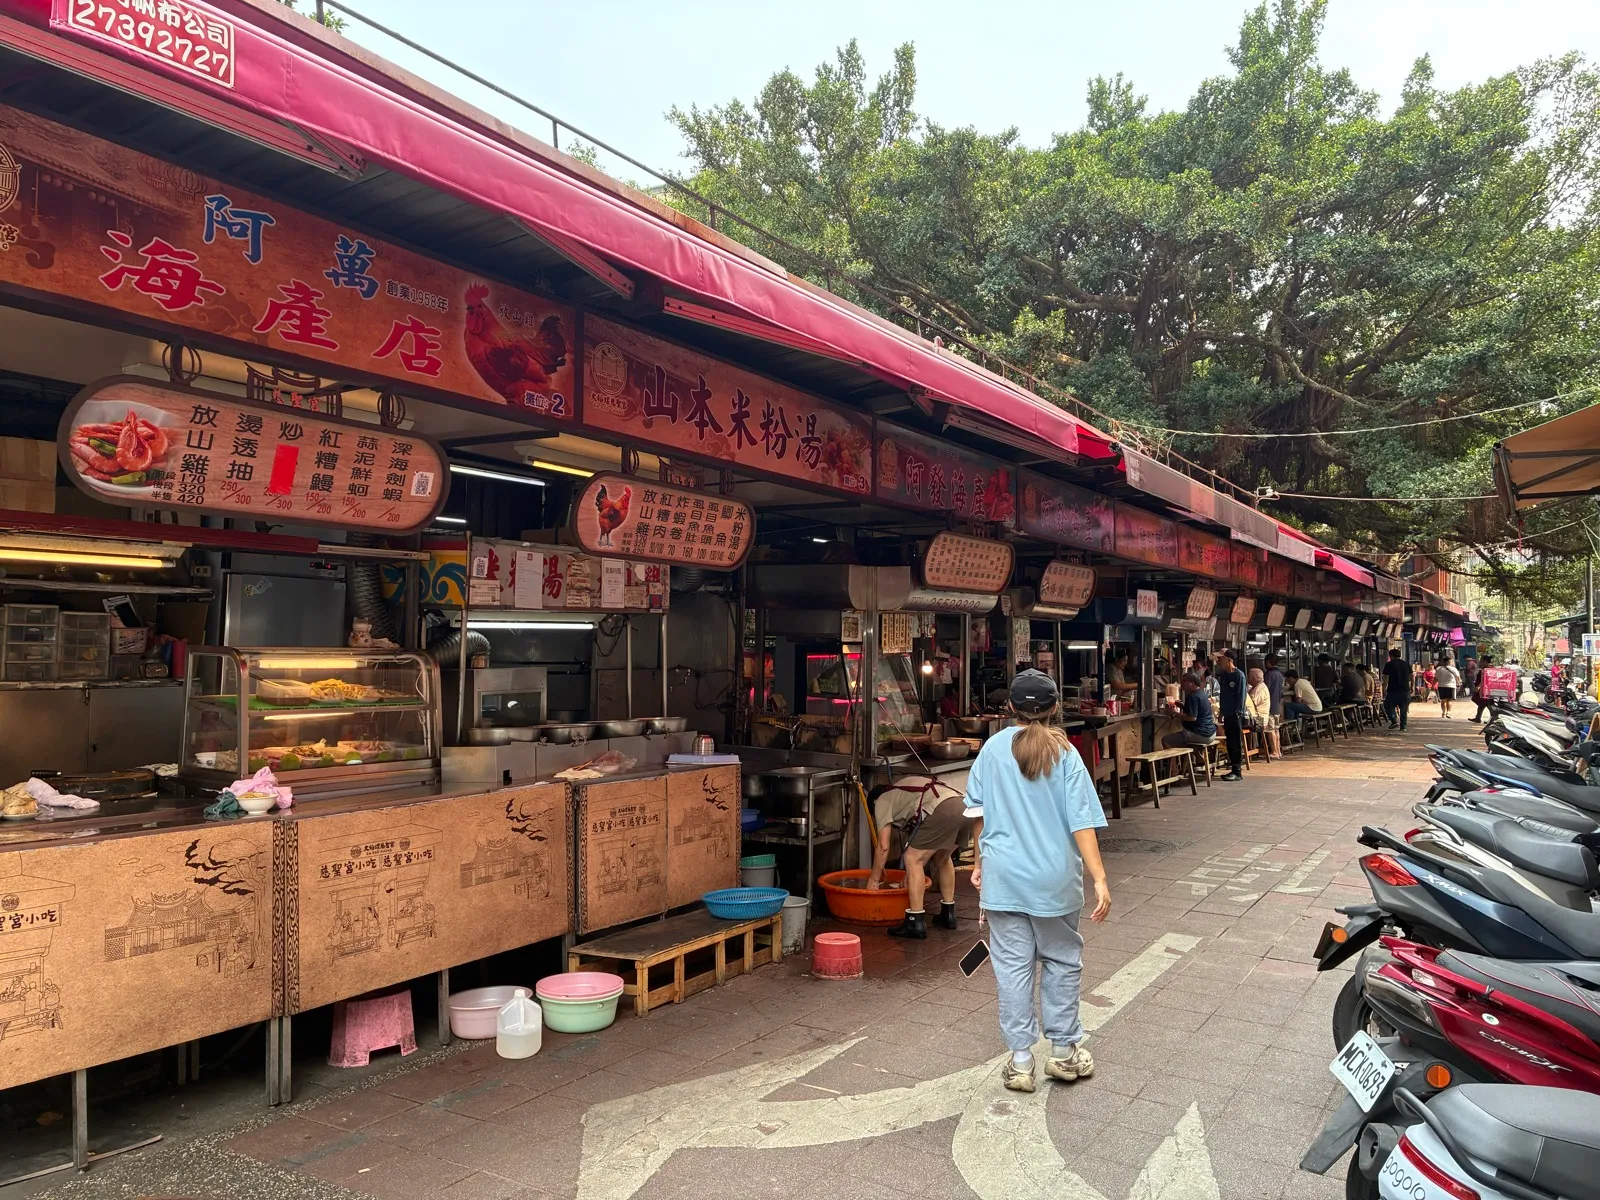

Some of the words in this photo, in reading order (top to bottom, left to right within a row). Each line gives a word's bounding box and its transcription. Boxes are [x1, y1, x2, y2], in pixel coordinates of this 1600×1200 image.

[75, 1, 229, 78] 27392727
[117, 0, 229, 50] 帆布公司
[100, 229, 444, 378] 海產店
[386, 280, 449, 312] 創業1958年
[180, 404, 220, 475] 放山雞
[642, 364, 823, 471] 山本米粉湯
[226, 412, 263, 481] 燙透抽
[310, 429, 343, 493] 紅糟鰻
[347, 435, 379, 497] 蒜泥鮮蚵
[177, 494, 204, 505] 420
[178, 483, 206, 494] 320
[182, 473, 206, 484] 170
[635, 489, 658, 537] 放山雞
[653, 493, 674, 539] 紅糟肉
[728, 507, 747, 549] 米粉湯
[320, 857, 377, 879] 慈聖宮小吃
[383, 848, 433, 868] 慈聖宮小吃
[1382, 1156, 1426, 1200] gogoro
